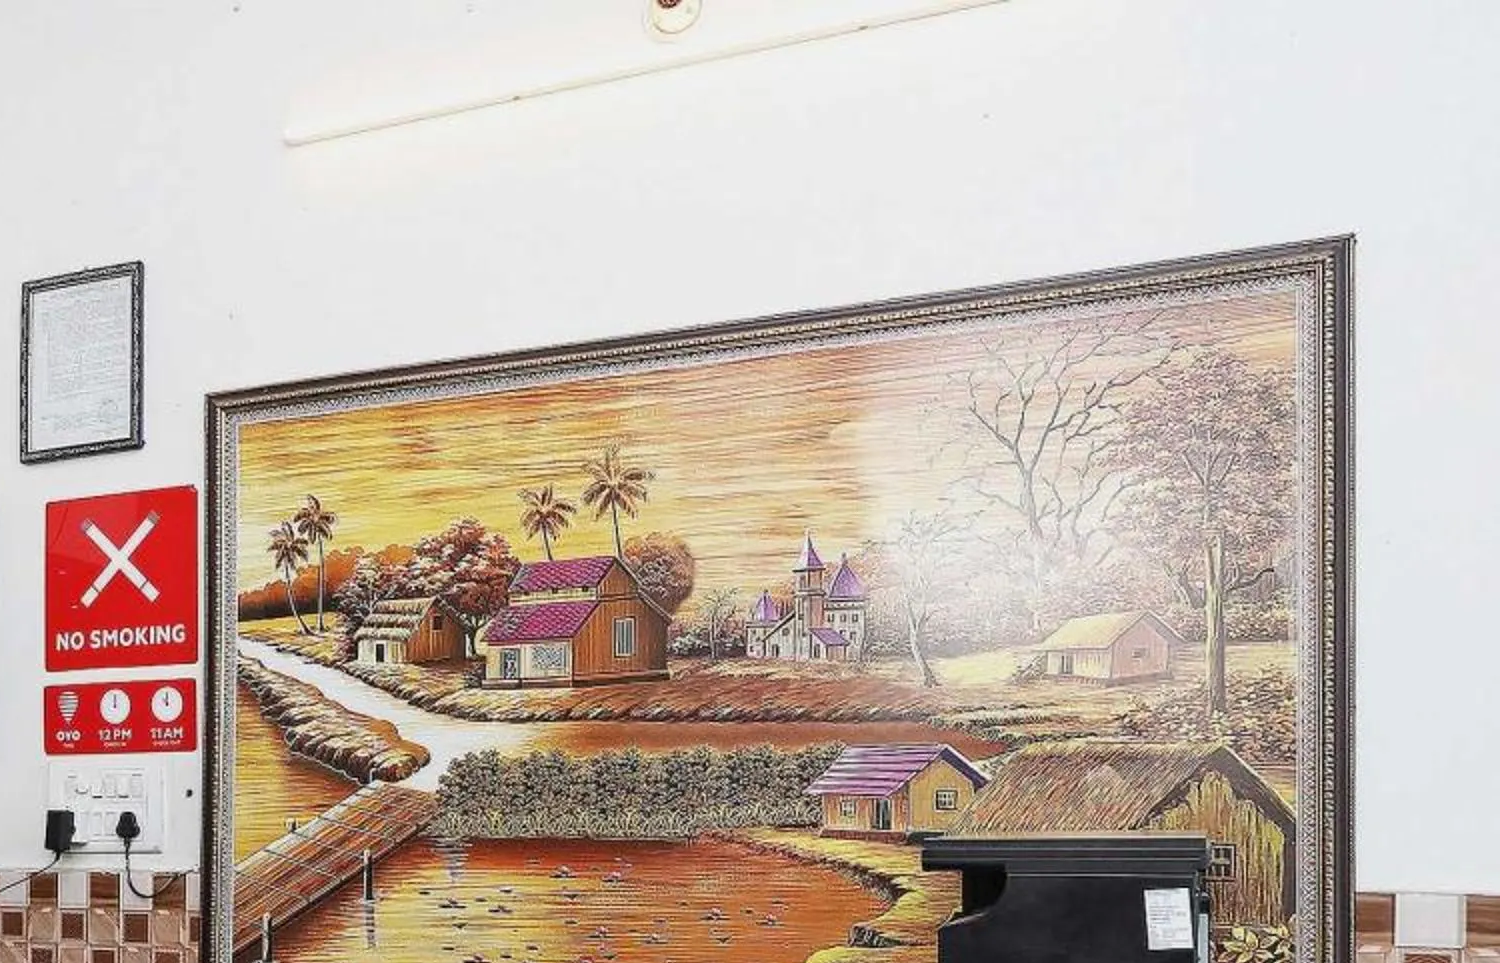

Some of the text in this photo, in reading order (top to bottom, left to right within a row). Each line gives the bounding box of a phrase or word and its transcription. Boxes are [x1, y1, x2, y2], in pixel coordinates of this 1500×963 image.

[56, 623, 186, 651] NO SMOKING
[56, 730, 81, 741] OYO
[113, 728, 132, 740] PM
[163, 726, 183, 738] AM
